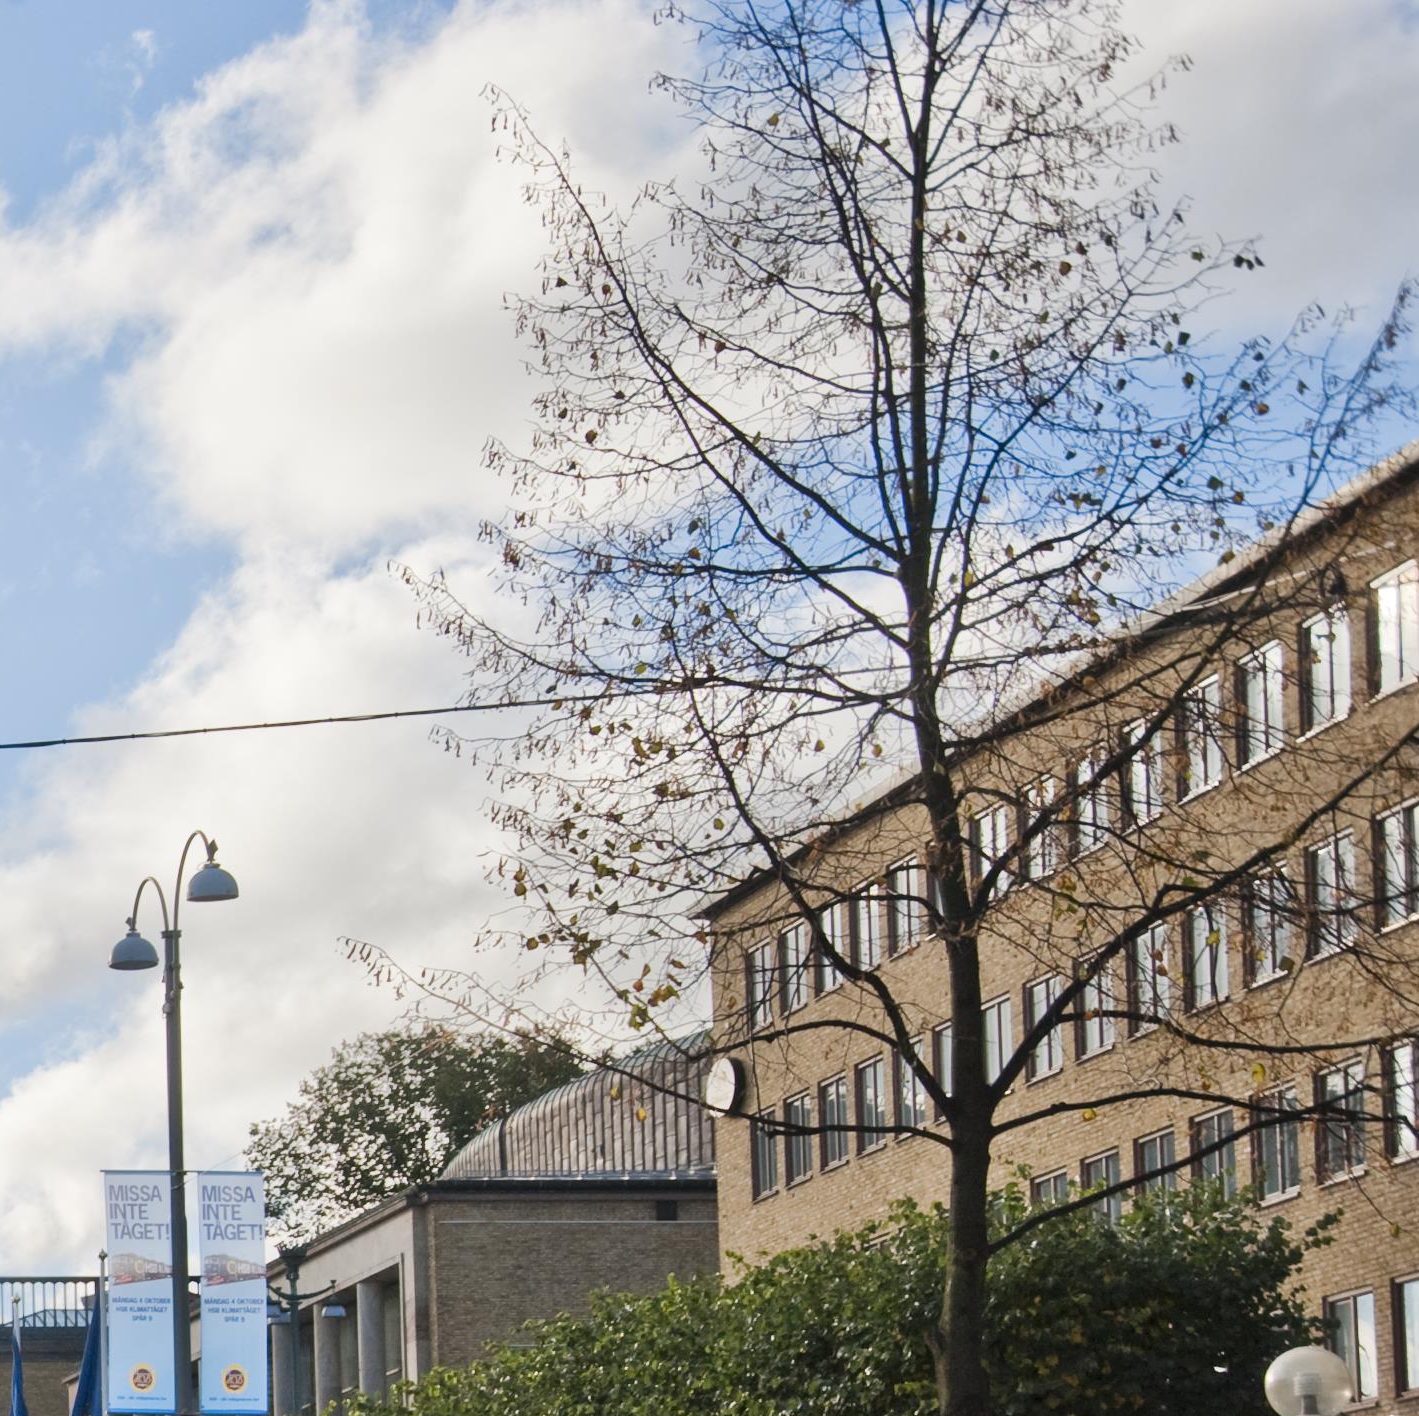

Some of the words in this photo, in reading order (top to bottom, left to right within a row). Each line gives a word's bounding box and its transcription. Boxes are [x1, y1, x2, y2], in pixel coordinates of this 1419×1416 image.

[108, 1185, 162, 1202] MISSA
[202, 1185, 256, 1203] MISSA
[109, 1203, 149, 1220] INTE
[203, 1203, 242, 1221] INTE
[111, 1220, 170, 1240] TÅGET!
[204, 1220, 263, 1241] TÅGET!
